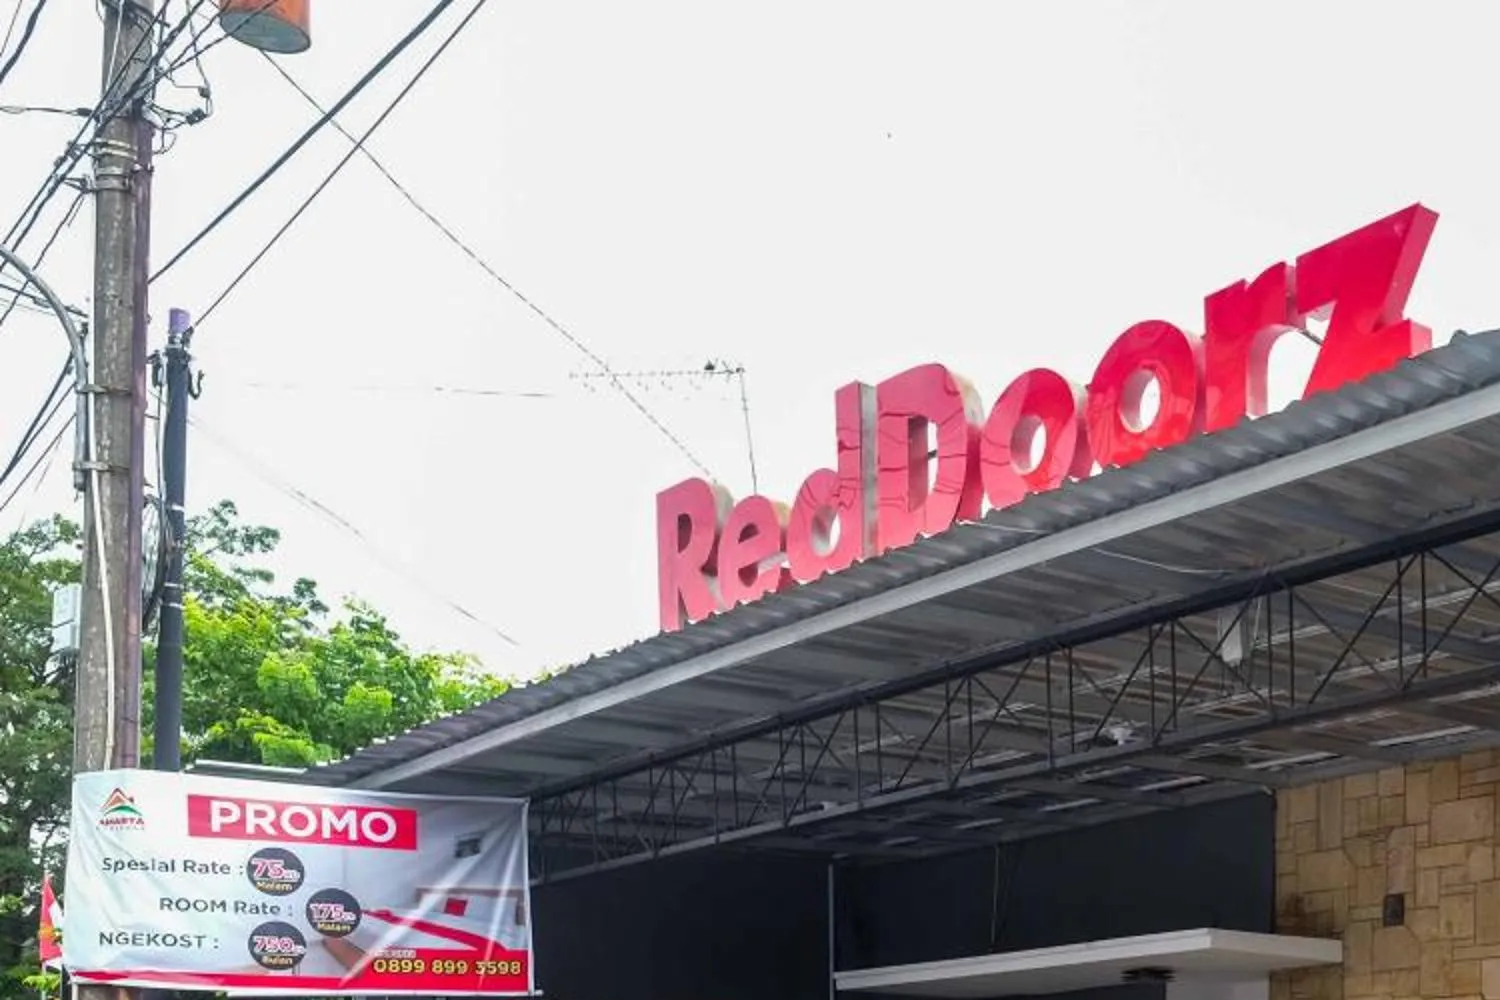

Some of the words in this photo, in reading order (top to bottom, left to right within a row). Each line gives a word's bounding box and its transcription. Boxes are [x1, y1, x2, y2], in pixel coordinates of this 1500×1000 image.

[656, 203, 1439, 632] RedDoorz
[210, 799, 397, 843] PROMO
[102, 857, 175, 873] Spesial
[183, 860, 231, 875] Rate
[159, 898, 227, 913] ROOM
[234, 901, 281, 916] Rate
[99, 932, 206, 949] NGEKOST
[373, 959, 425, 973] 0899
[431, 959, 468, 975] 899
[474, 961, 521, 975] 3598
